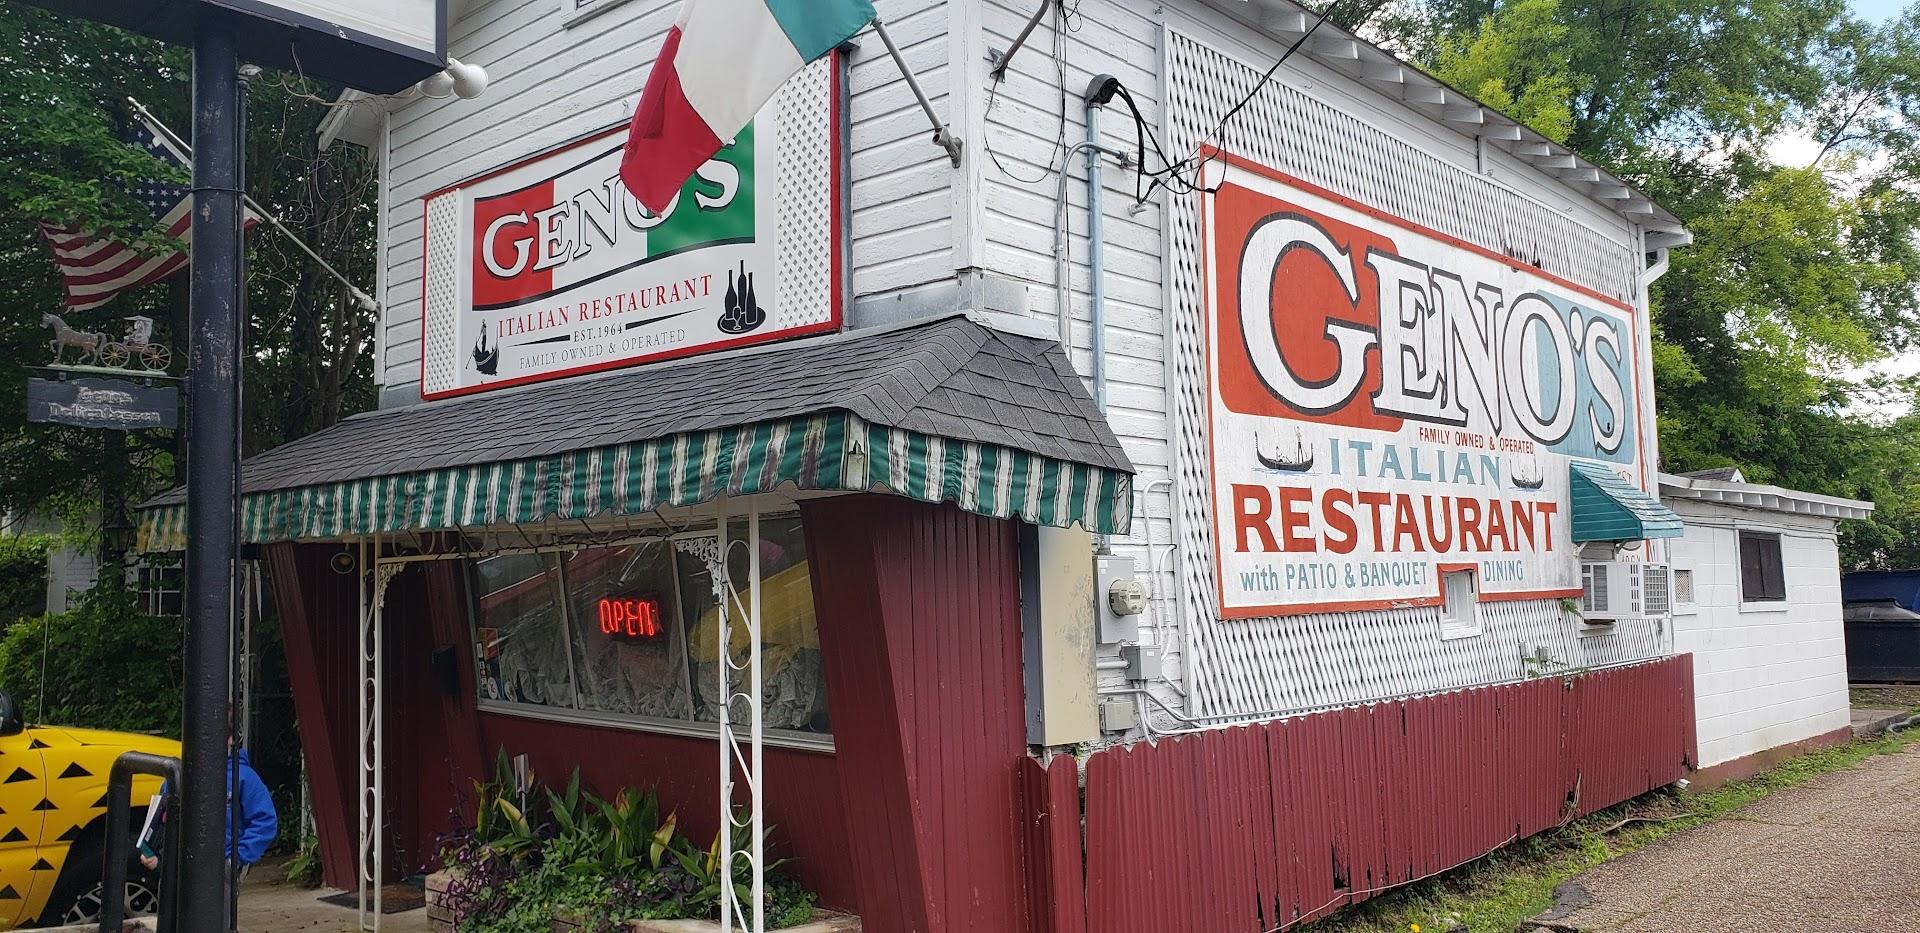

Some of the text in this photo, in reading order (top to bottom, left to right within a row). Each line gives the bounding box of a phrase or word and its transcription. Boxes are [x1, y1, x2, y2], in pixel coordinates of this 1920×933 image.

[481, 138, 741, 280] GENOS
[498, 274, 713, 338] ITALIAN RESTAURANT
[520, 328, 686, 370] FAMILY OWNED & OPERATED
[1237, 211, 1628, 457] GENO'S
[1328, 437, 1501, 490] ITALIAN
[1419, 426, 1535, 455] FAMILY OWNED & OPERATED
[1230, 483, 1558, 555] RESTAURANT
[1239, 560, 1524, 592] with PATIO & BANQUET DINING
[599, 599, 655, 636] OPEN
